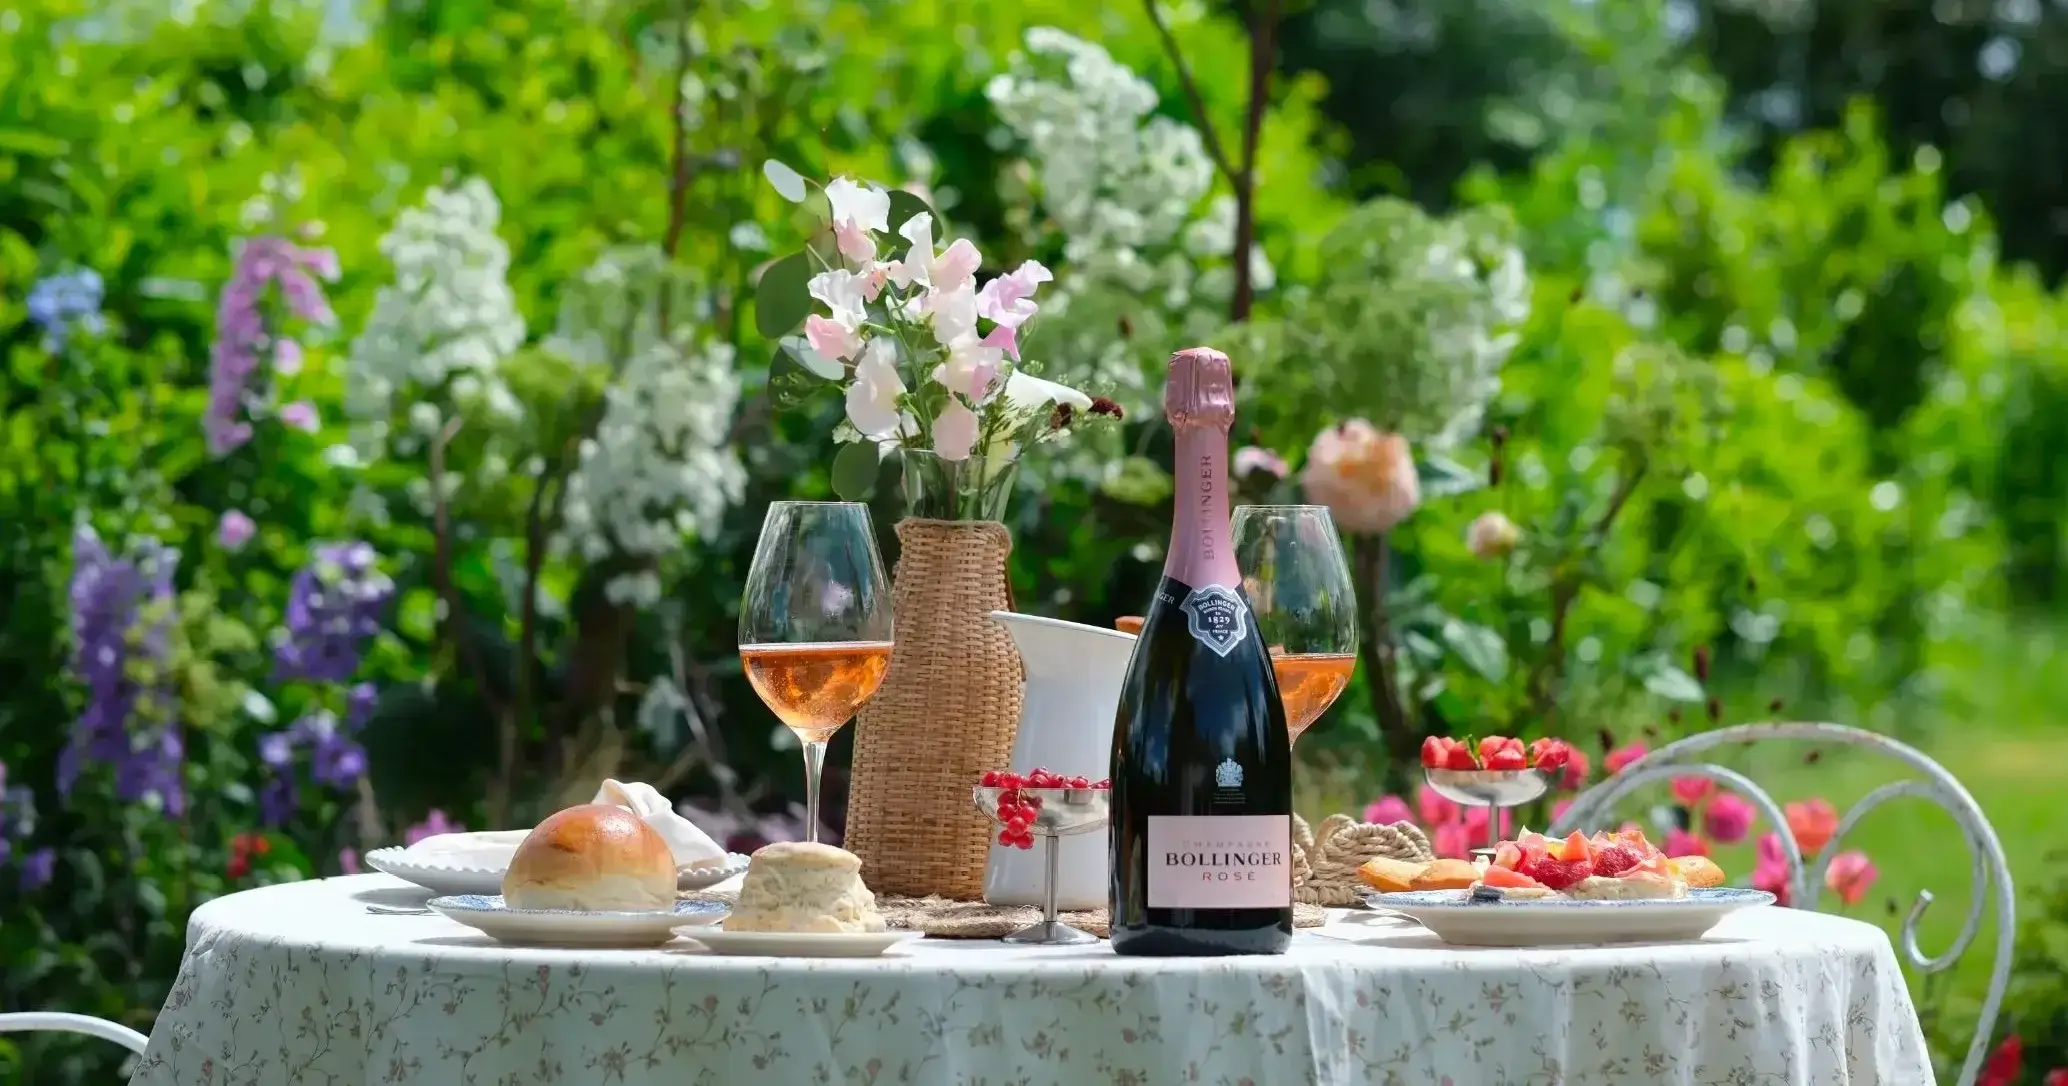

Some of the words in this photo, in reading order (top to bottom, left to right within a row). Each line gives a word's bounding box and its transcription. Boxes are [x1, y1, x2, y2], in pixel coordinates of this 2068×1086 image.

[1200, 455, 1214, 560] BOLLINGER
[1198, 600, 1235, 610] BOLLINGER
[1208, 616, 1230, 625] 1829
[1166, 851, 1281, 867] BOLLINGER
